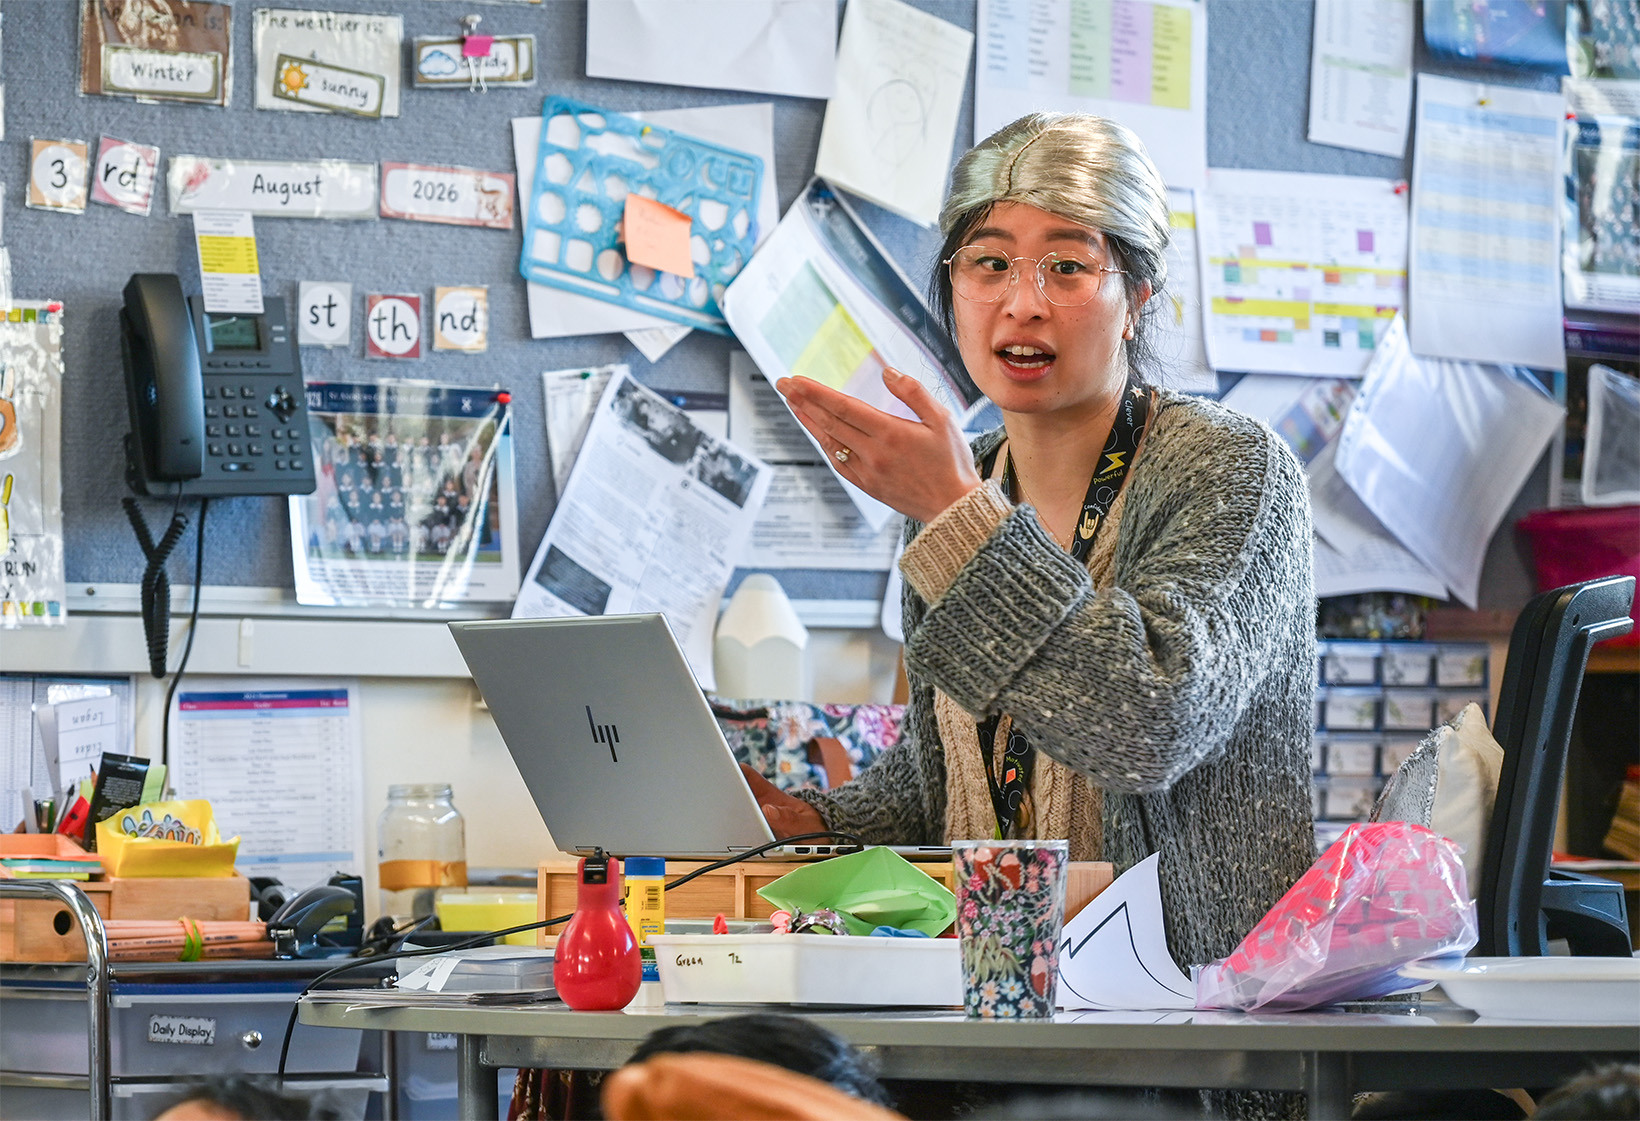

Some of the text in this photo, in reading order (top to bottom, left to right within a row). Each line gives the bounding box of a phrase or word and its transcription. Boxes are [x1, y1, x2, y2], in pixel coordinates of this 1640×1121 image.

[131, 61, 194, 82] Winter
[320, 78, 369, 107] sunny
[51, 159, 67, 188] 3
[104, 157, 140, 192] rd
[252, 174, 322, 205] August
[413, 180, 459, 202] 2026
[310, 294, 337, 328] st
[373, 306, 411, 341] th
[440, 299, 478, 333] nd
[1124, 399, 1134, 428] Clever
[1093, 470, 1124, 484] Powerful
[72, 708, 103, 726] Logan
[585, 705, 620, 763] hp
[1006, 756, 1025, 783] Motivated
[675, 953, 704, 967] Green
[152, 1021, 212, 1041] Daily Display
